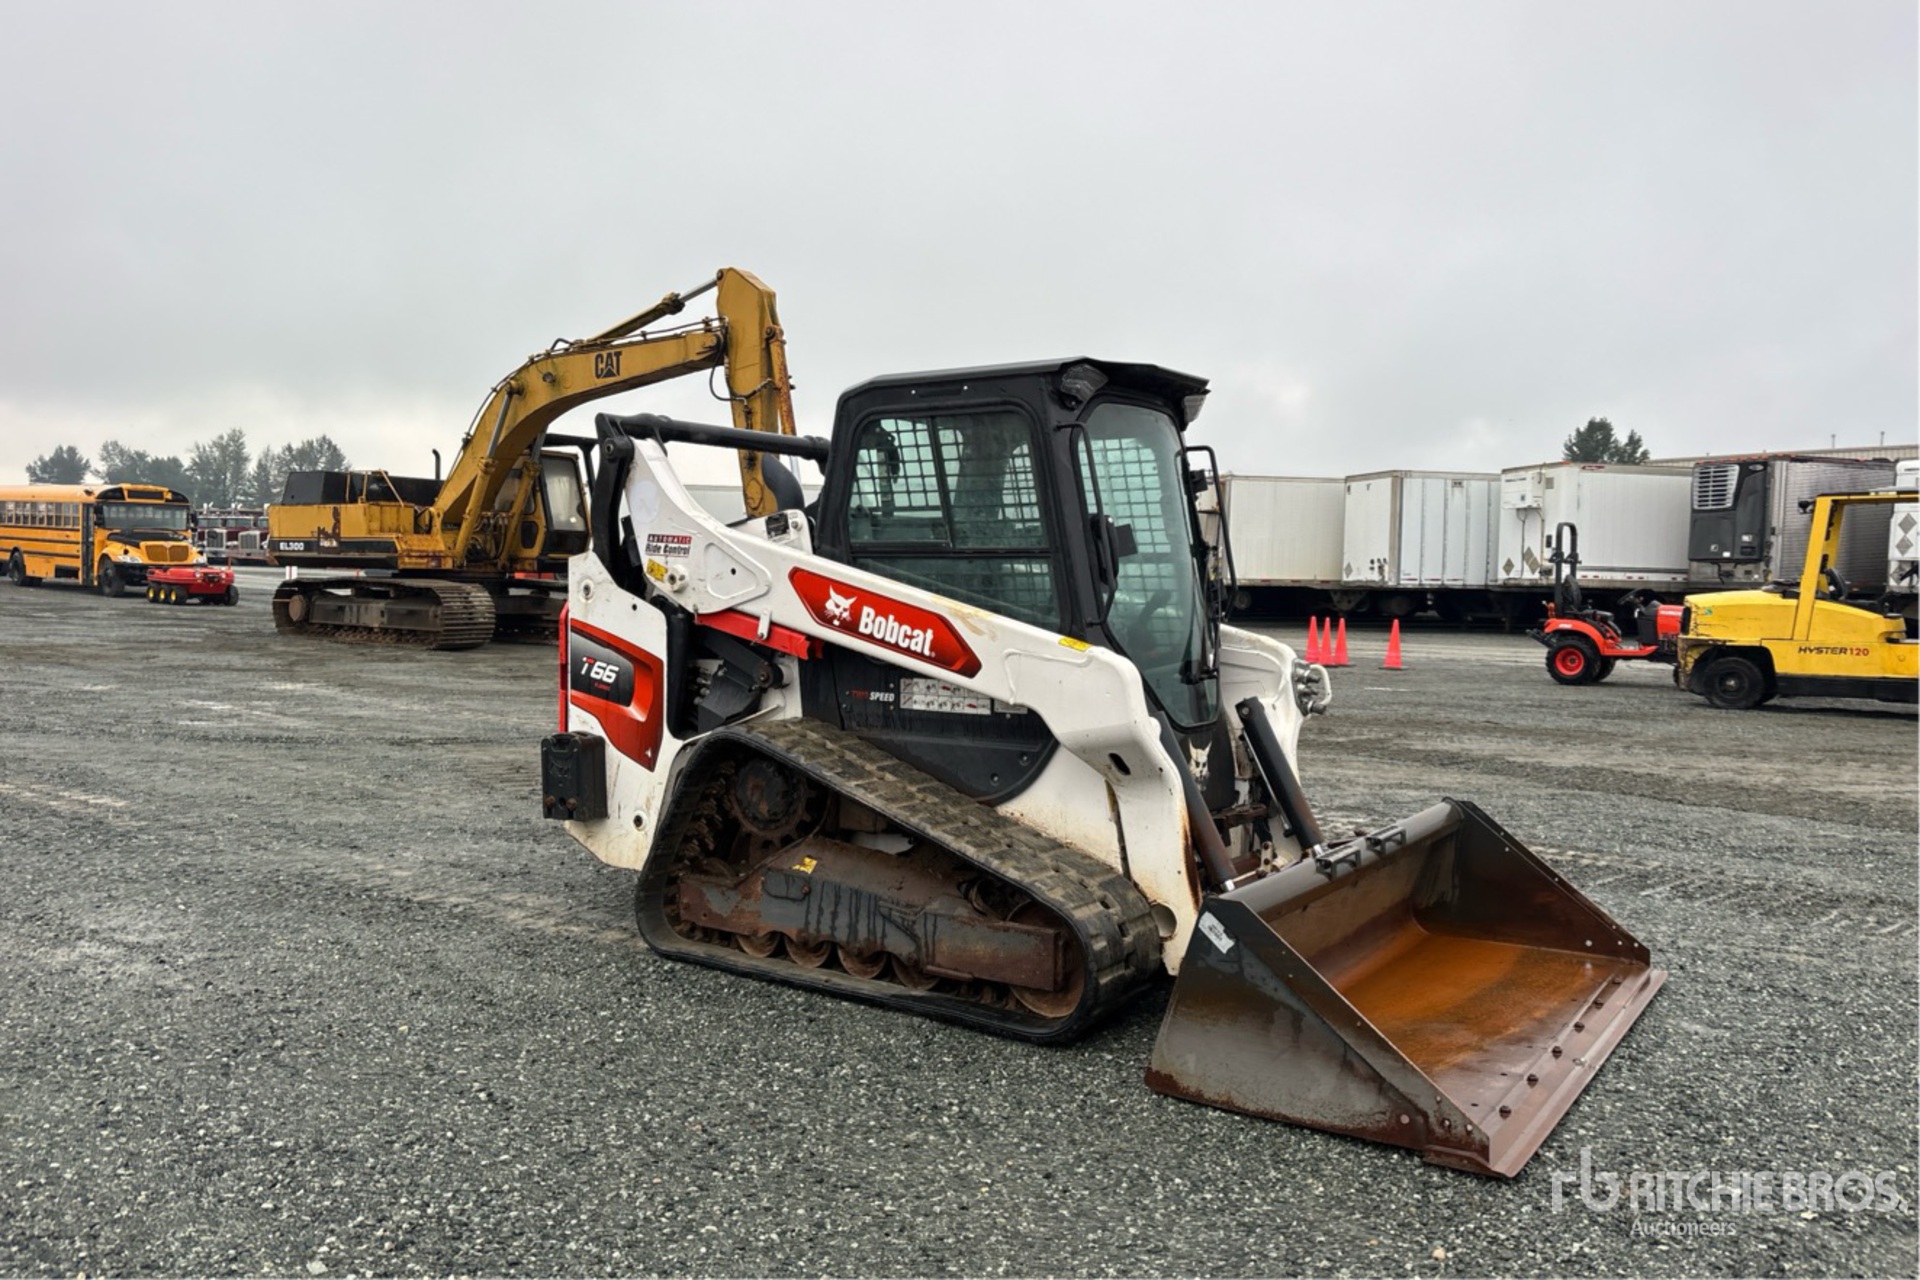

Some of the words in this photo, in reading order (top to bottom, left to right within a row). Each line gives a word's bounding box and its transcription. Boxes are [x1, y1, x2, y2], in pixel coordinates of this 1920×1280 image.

[595, 350, 622, 379] CAT
[646, 543, 661, 553] Ride
[663, 544, 690, 555] Control
[858, 606, 933, 656] Bobcat
[1798, 646, 1847, 655] HYSTER
[1850, 647, 1869, 656] 120
[581, 656, 619, 683] T66
[870, 691, 894, 702] SPEED
